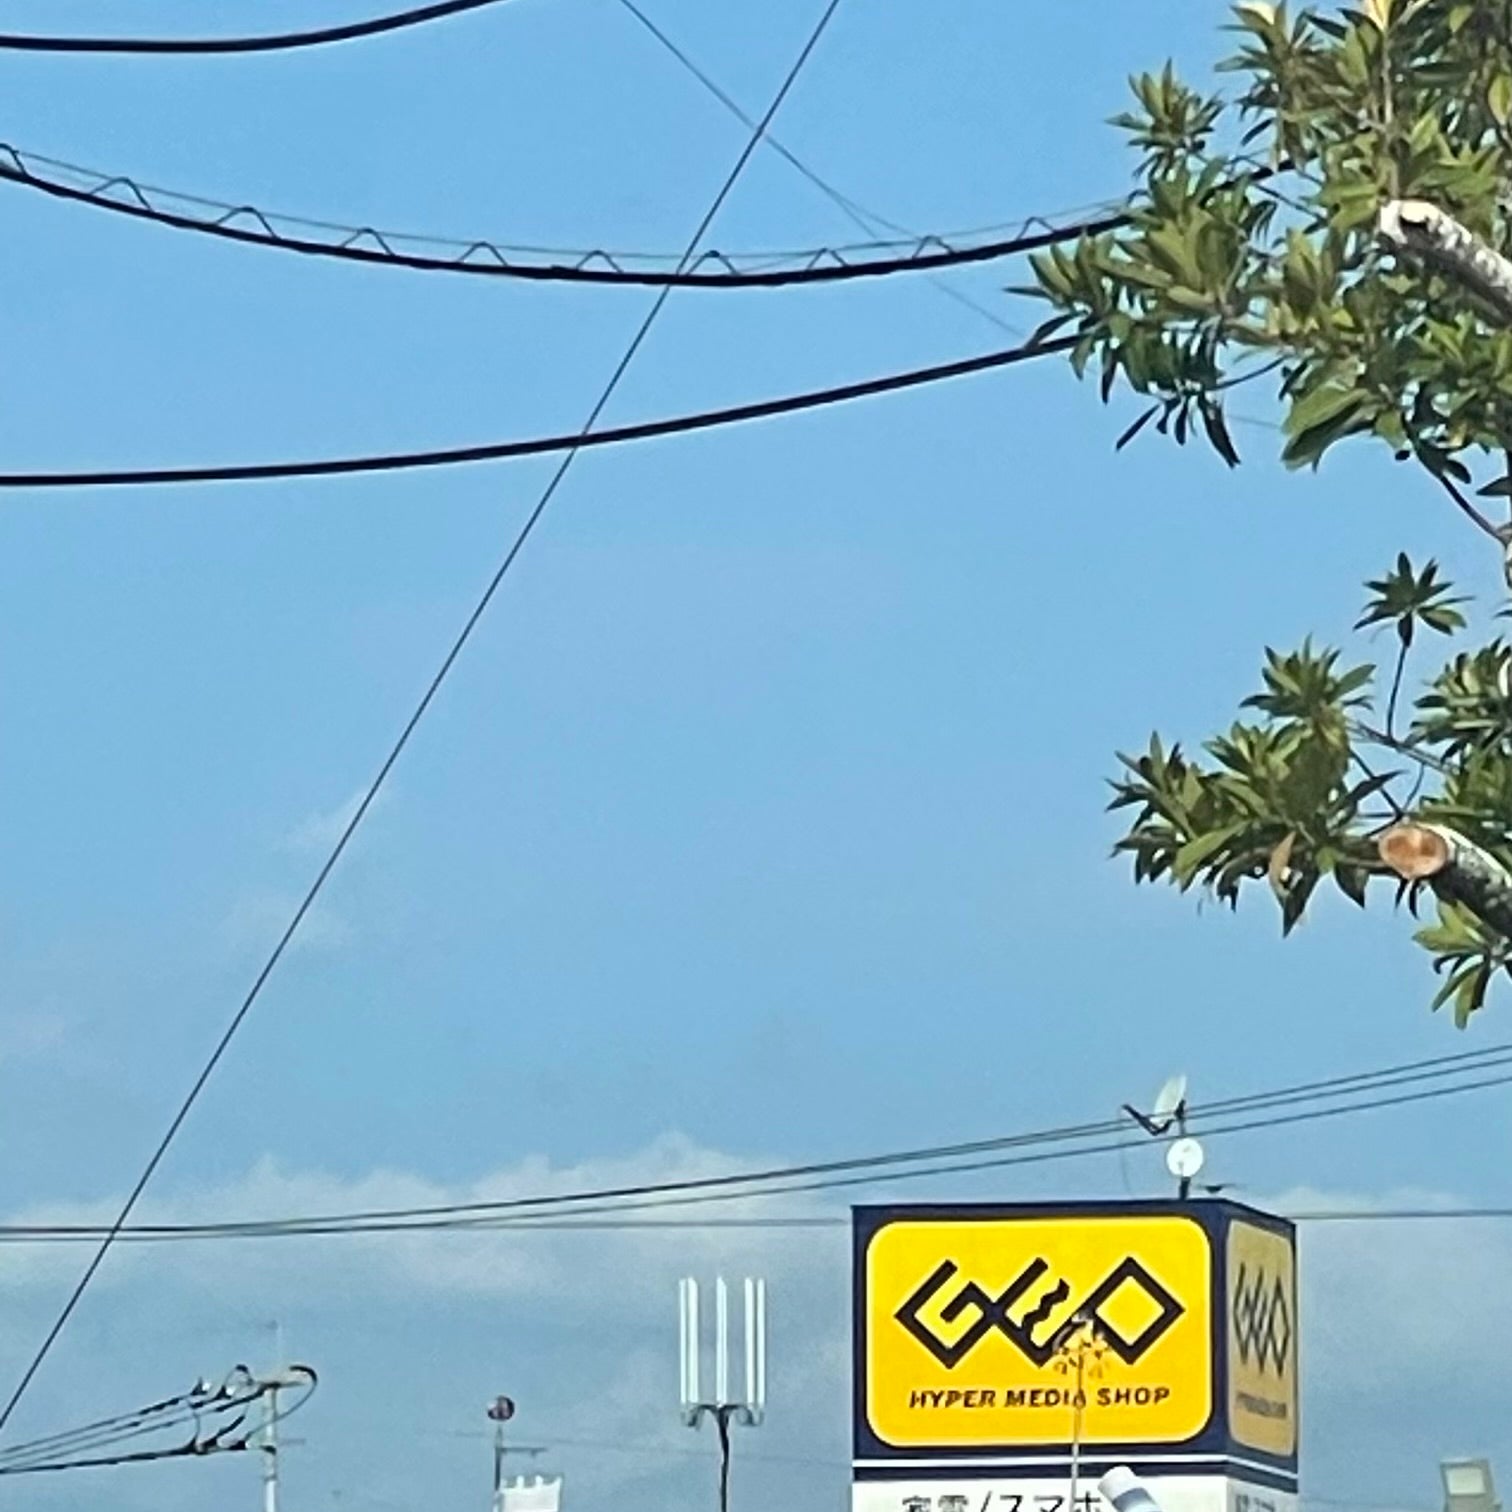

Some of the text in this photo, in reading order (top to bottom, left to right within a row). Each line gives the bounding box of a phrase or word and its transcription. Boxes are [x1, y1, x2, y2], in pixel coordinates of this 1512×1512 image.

[894, 1256, 1186, 1369] GEO
[909, 1387, 1170, 1409] HYPER MEDIA SHOP
